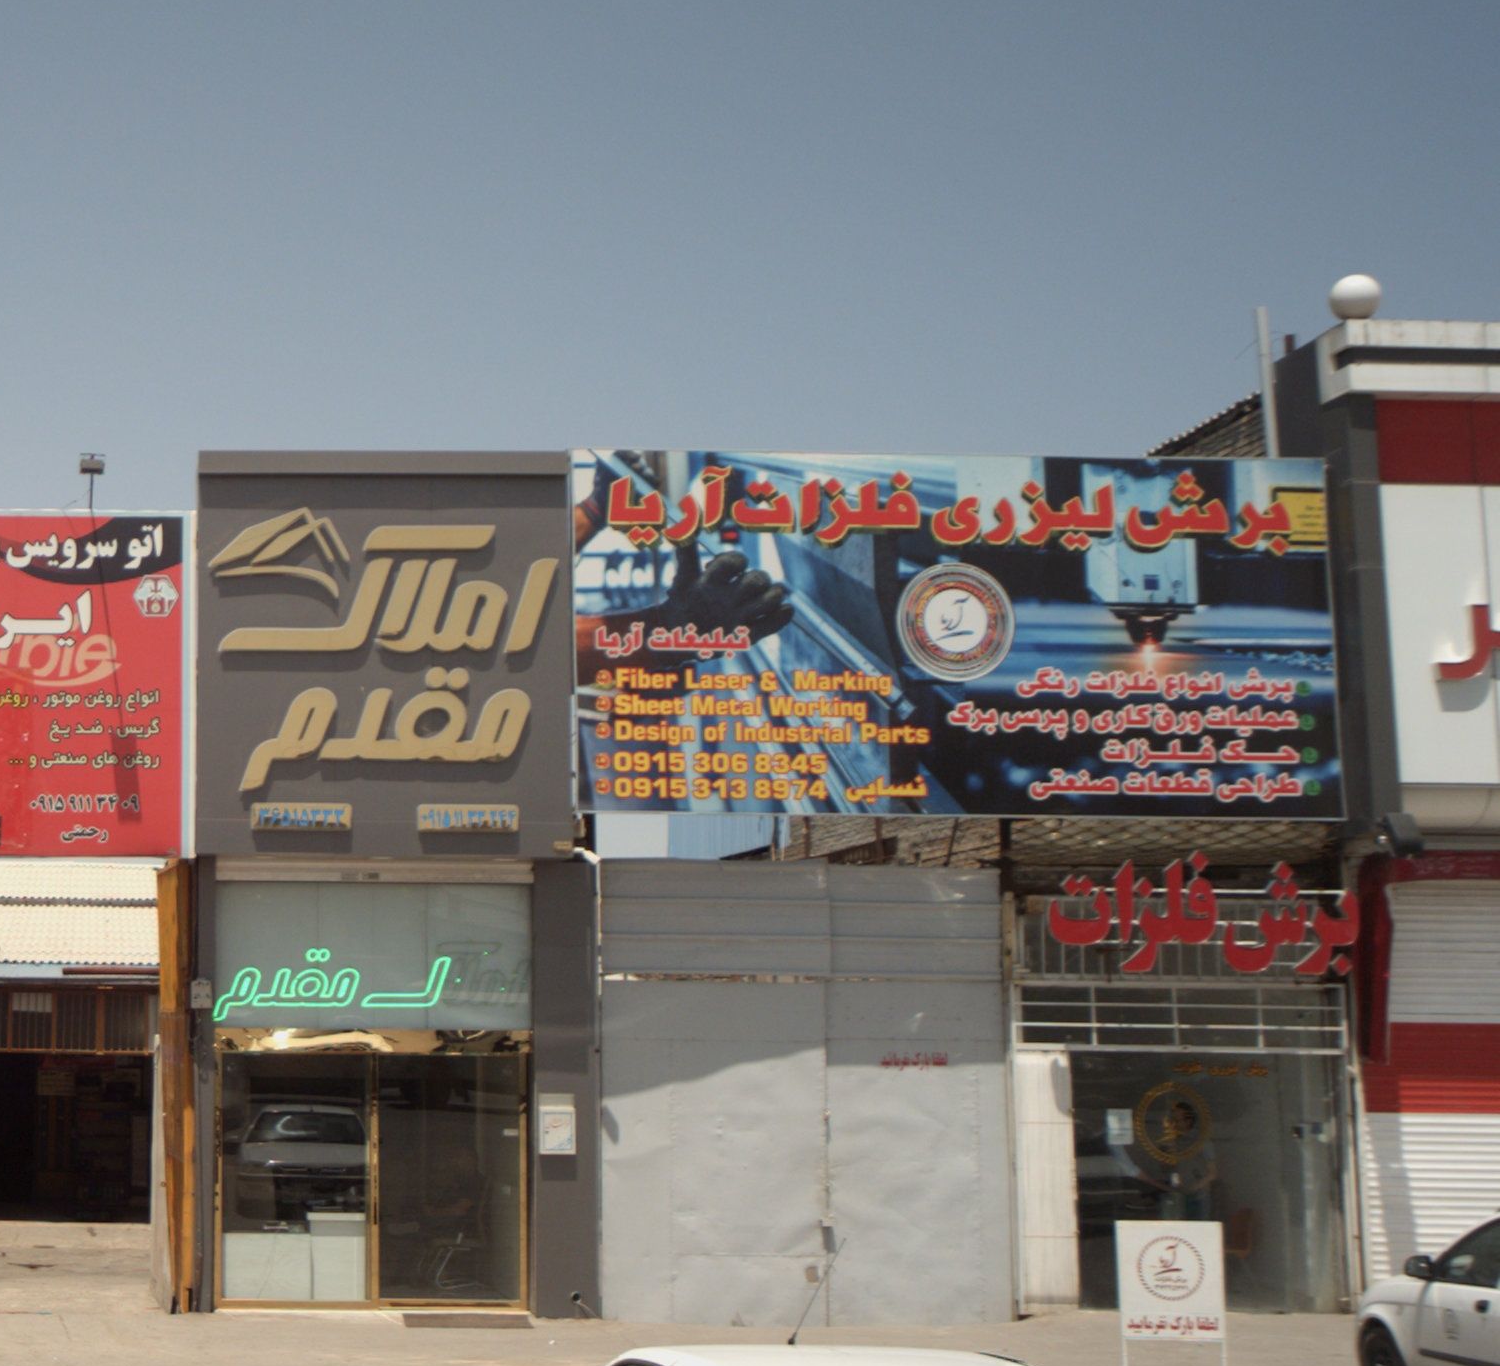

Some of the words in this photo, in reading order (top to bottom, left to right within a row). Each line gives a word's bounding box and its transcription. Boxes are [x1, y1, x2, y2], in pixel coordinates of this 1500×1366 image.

[608, 465, 733, 547] آریا
[732, 470, 922, 547] فلزات
[931, 479, 1116, 551] لیزری
[1126, 471, 1293, 556] برش
[5, 532, 118, 569] سرویس
[123, 522, 164, 570] اتو
[218, 523, 560, 654] املاک
[595, 621, 644, 659] آریا
[648, 623, 750, 660] تبلیغات
[615, 668, 678, 691] Fiber
[684, 669, 753, 691] Laser
[759, 670, 779, 692] &
[793, 669, 893, 695] Marking
[1016, 666, 1080, 698] رنگی
[1085, 670, 1160, 699] فلزات
[1163, 671, 1224, 700] انواع
[1227, 667, 1295, 703] برش
[42, 690, 81, 708] موتور
[84, 688, 121, 708] روغن
[124, 690, 160, 712] انواع
[614, 694, 686, 717] Sheet
[690, 695, 763, 717] Metal
[769, 696, 868, 721] Working
[48, 718, 71, 743] یخ
[75, 719, 103, 735] ضد
[116, 716, 161, 739] گریس
[238, 665, 532, 792] مقدم
[614, 719, 697, 746] Design
[703, 721, 727, 743] of
[735, 721, 852, 745] Industrial
[859, 722, 931, 745] Parts
[1000, 707, 1069, 741] پرس
[1073, 708, 1089, 734] و
[1090, 703, 1151, 734] کاری
[1153, 702, 1203, 735] ورق
[1204, 704, 1299, 737] عملیات
[28, 757, 38, 769] و
[40, 752, 88, 769] صنعتی
[92, 752, 119, 770] های
[123, 753, 160, 770] روغن
[614, 752, 686, 774] 0915
[692, 753, 749, 774] 306
[754, 753, 828, 775] 8345
[1101, 735, 1217, 769] فلزات
[614, 778, 687, 799] 0915
[693, 778, 748, 800] 313
[753, 778, 828, 800] 8974
[1029, 767, 1120, 801] صنعتی
[1122, 768, 1214, 795] قطعات
[1215, 772, 1303, 803] طراحی
[30, 793, 66, 813] ۰۹۱۵
[69, 793, 93, 812] ۹۱۱
[1048, 849, 1218, 974] فلزات
[1223, 860, 1361, 977] برش
